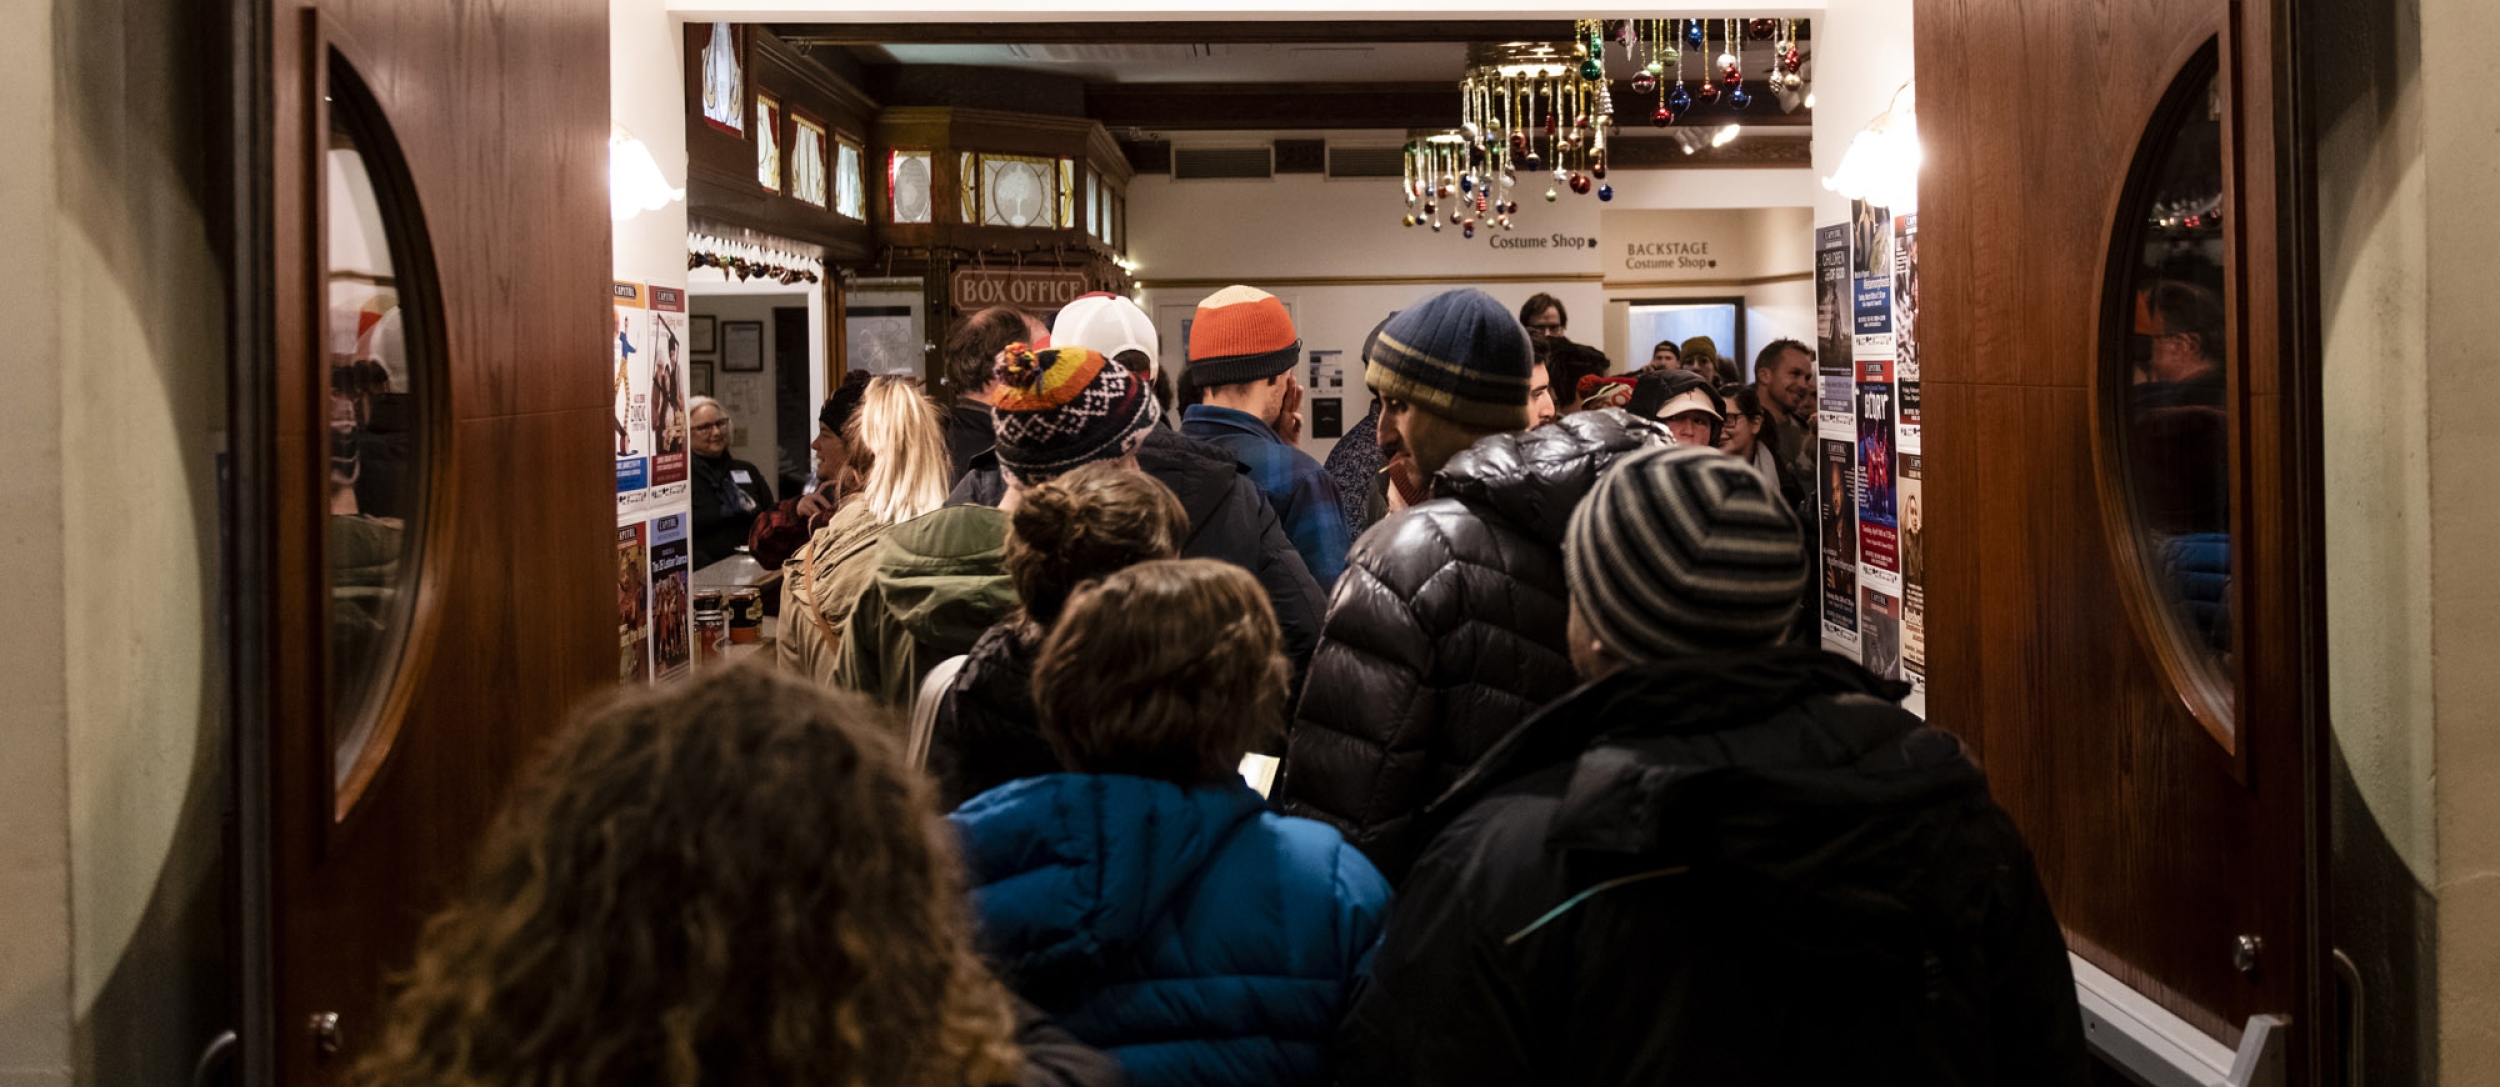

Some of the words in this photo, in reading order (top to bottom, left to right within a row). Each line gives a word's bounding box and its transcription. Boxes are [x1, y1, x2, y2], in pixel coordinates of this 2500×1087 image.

[1489, 234, 1547, 249] Costume
[1552, 233, 1585, 250] Shop
[1627, 242, 1708, 256] BACKSTAGE
[1625, 257, 1674, 269] Costume
[1678, 256, 1706, 271] Shop
[1822, 250, 1846, 266] CHILDREN
[1830, 267, 1836, 281] OF
[1836, 266, 1846, 280] GOD
[614, 284, 636, 298] CAPITOL
[657, 291, 676, 302] CAPITOL
[963, 279, 1006, 302] BOX
[1010, 279, 1081, 302] OFFICE
[1865, 363, 1882, 373] CAPITOL
[658, 517, 678, 532] CAPITOL
[618, 527, 636, 542] APITOL
